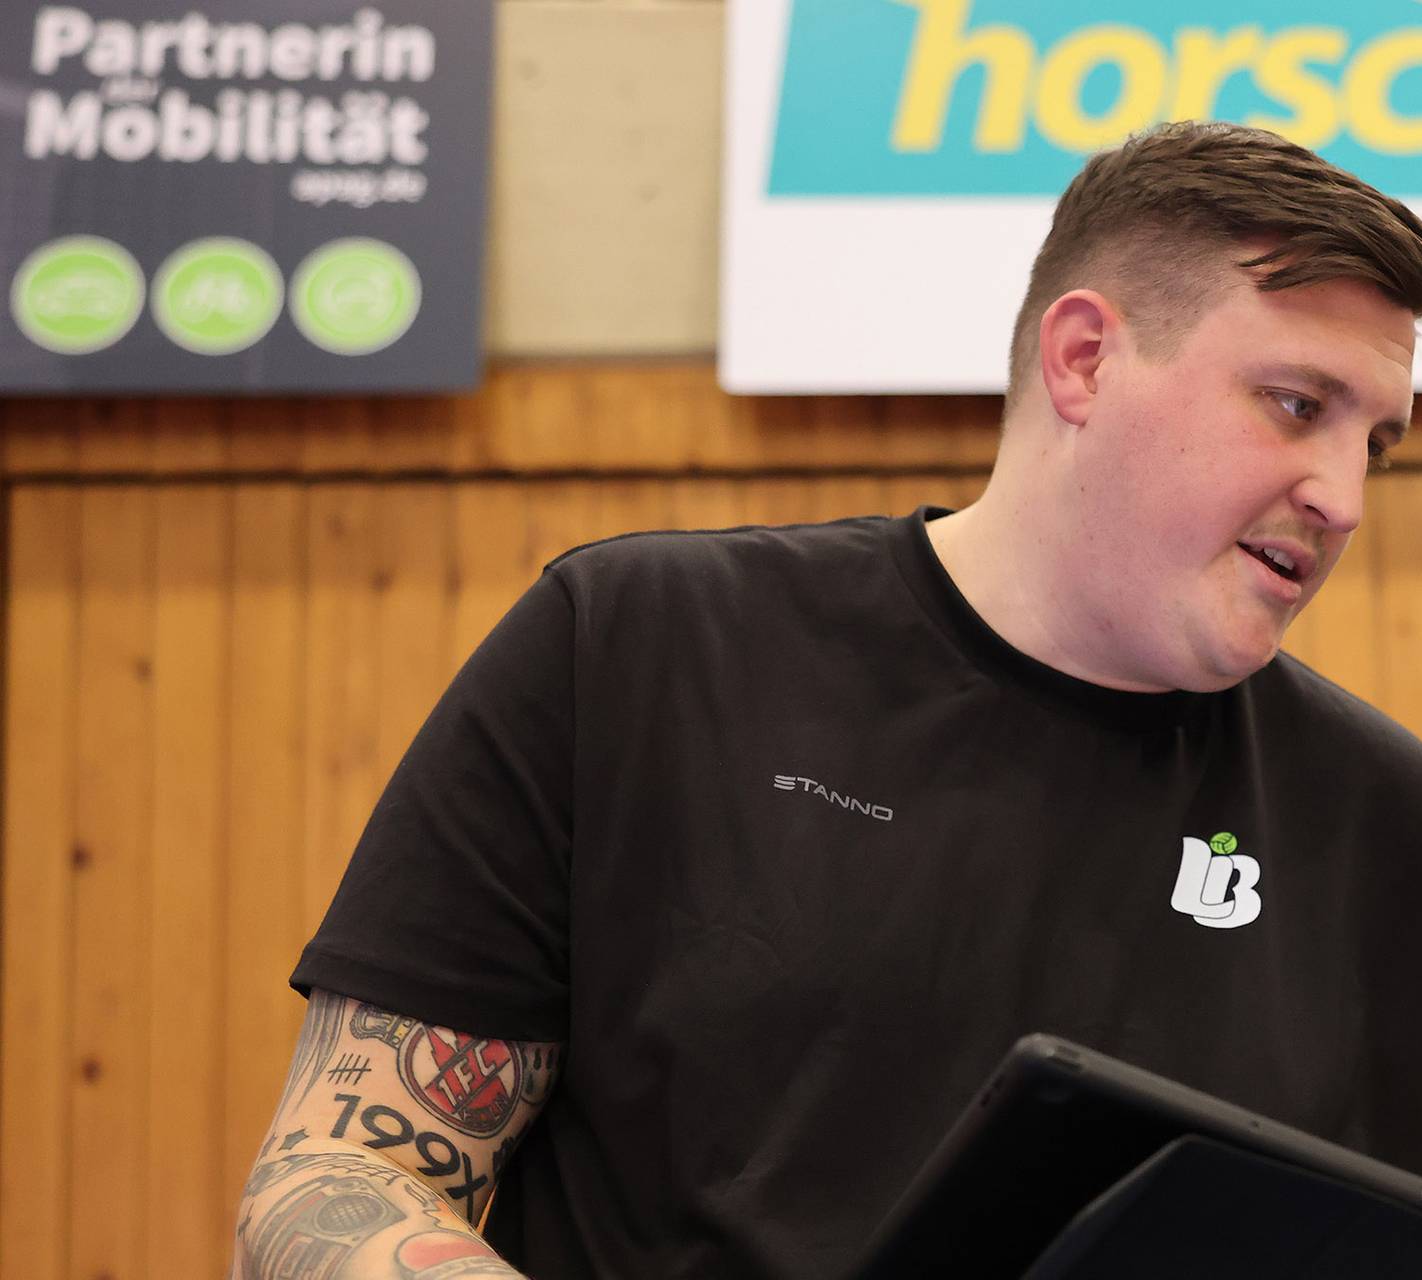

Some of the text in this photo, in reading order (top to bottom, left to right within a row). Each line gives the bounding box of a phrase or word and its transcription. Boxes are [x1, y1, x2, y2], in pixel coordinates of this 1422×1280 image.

[32, 6, 436, 82] Partnerin
[25, 89, 430, 165] Mobilität
[774, 774, 893, 821] STANNO
